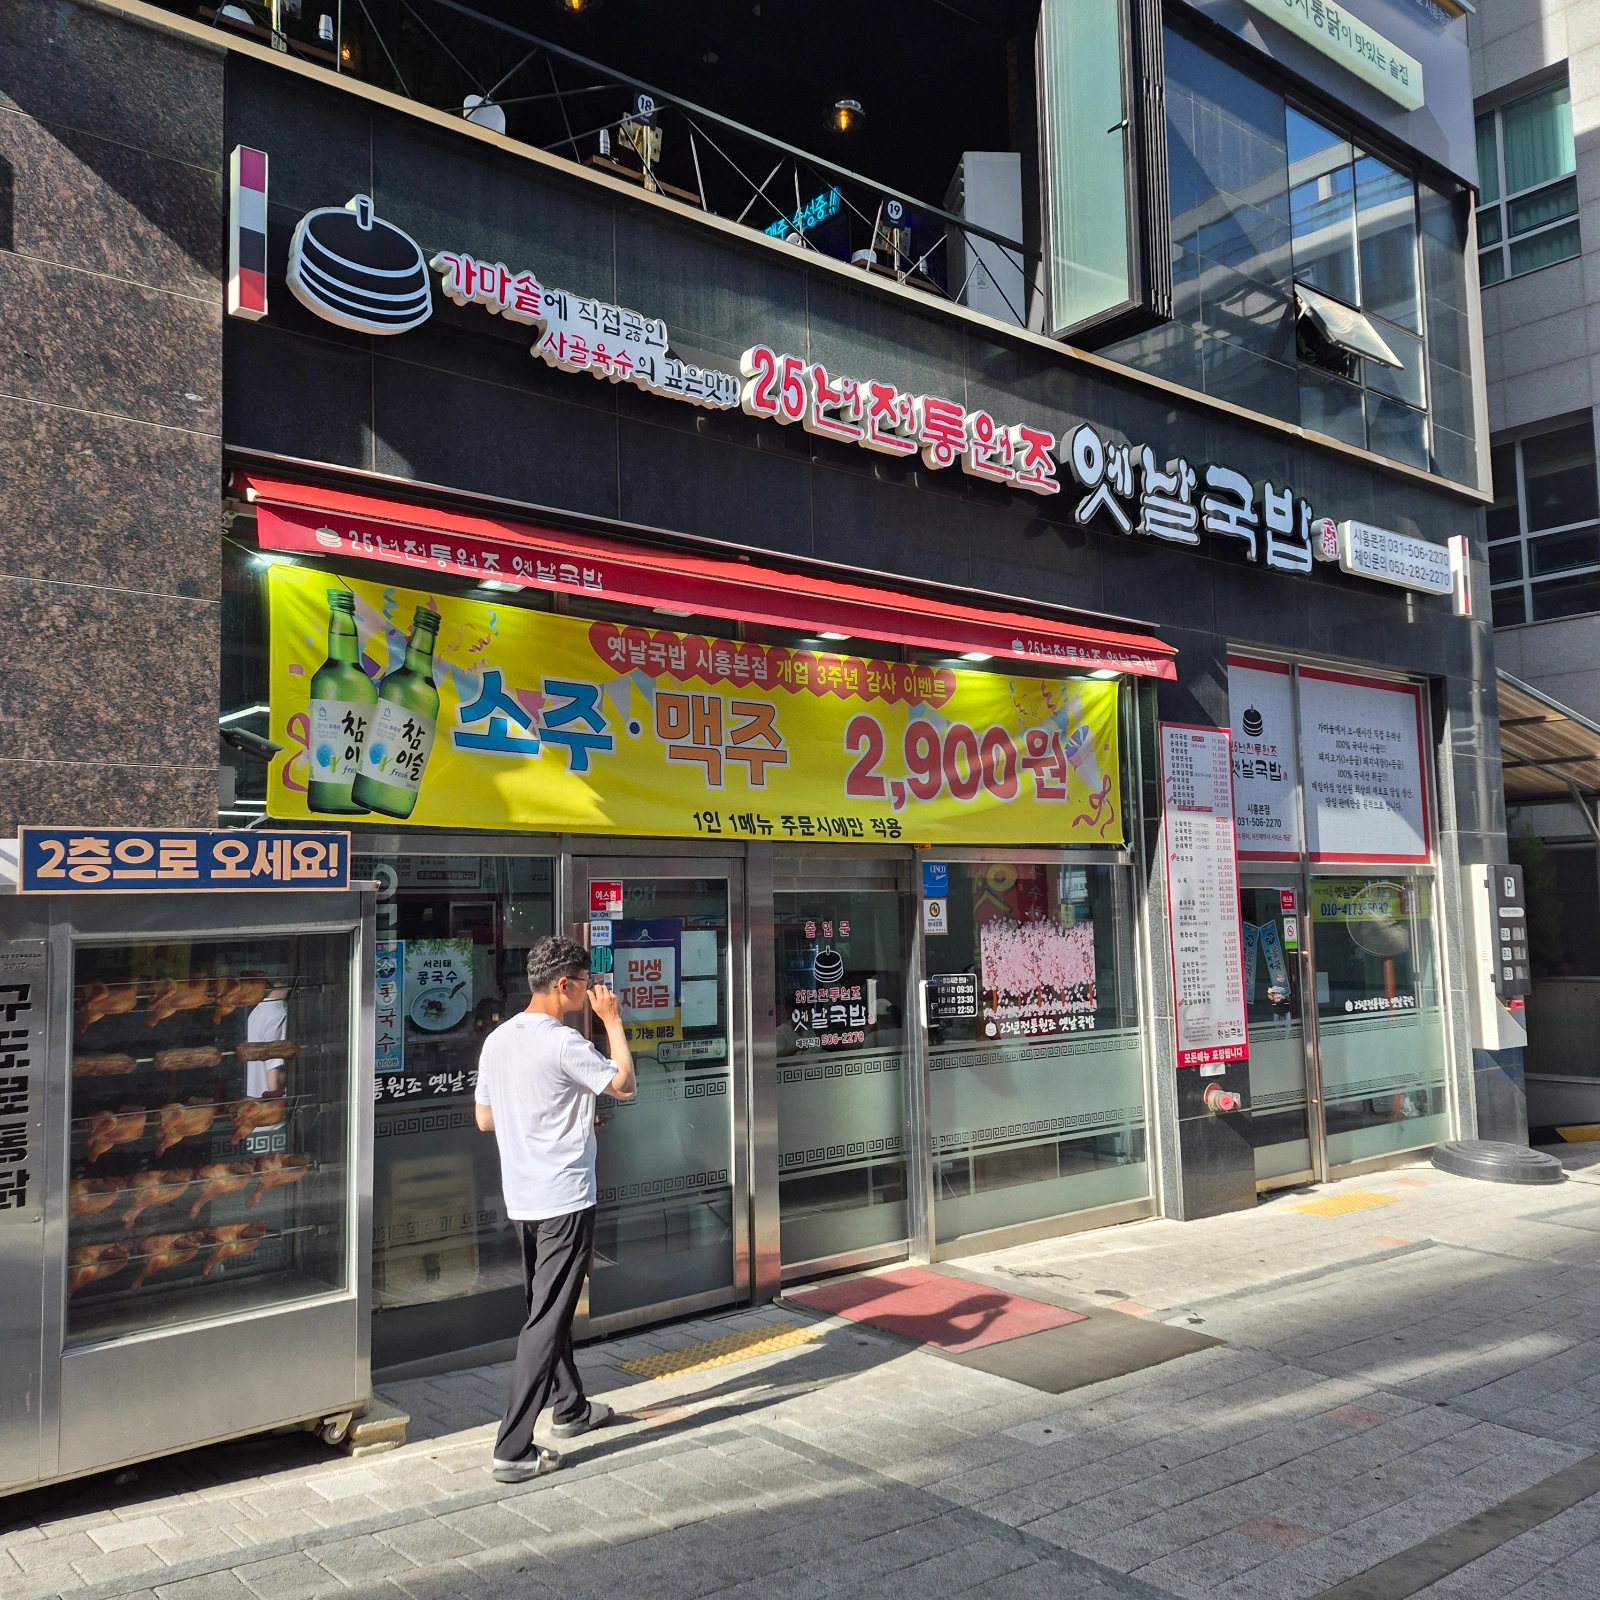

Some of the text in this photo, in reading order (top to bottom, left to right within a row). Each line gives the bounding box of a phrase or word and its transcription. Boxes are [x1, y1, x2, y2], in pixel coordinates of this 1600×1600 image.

[1355, 33, 1386, 71] 맛있는
[1389, 58, 1409, 86] 술집
[640, 97, 652, 111] 18
[890, 203, 901, 216] 19
[442, 255, 568, 320] 가마솥에
[543, 332, 656, 382] 사골육수의
[752, 346, 1060, 493] 25년전통원조
[1072, 424, 1313, 574] 옛날국밥
[1353, 528, 1449, 566] 시흥본점 031-506-2270
[349, 530, 603, 592] 25년전통원조 옛날국밥
[1354, 549, 1450, 586] 체인문의 052-282-2270
[1027, 640, 1158, 672] 25년전통원조 옛날국밥
[607, 636, 947, 700] 옛날국밥 시흥본점 개업 3주년 감사 이벤트
[1335, 740, 1369, 752] 100% 국내산
[389, 768, 409, 779] fresh
[1337, 769, 1370, 781] 100% 국내산
[693, 811, 903, 839] 1인 1메뉴 주문시에만 적용
[1237, 817, 1281, 828] 031-506-2270
[36, 836, 338, 883] 2층으로 오세요!
[595, 890, 617, 900] 에스원
[1501, 929, 1509, 938] B1
[1503, 949, 1510, 958] B2
[423, 959, 452, 968] 서리태
[628, 959, 662, 982] 민생
[417, 971, 458, 985] 콩국수
[1504, 969, 1512, 977] B3
[956, 985, 973, 993] 09:30
[619, 985, 671, 1011] 지원금
[791, 1003, 866, 1032] 옛날국밥
[957, 1006, 974, 1014] 22:50
[377, 983, 397, 1054] 콩국수
[1000, 1015, 1096, 1035] 25년전통원조 옛날국밥
[636, 1026, 675, 1040] 가능 매장
[821, 1031, 865, 1046] 506-2270
[661, 1049, 670, 1057] 19
[1184, 1046, 1243, 1064] 모든메뉴 포장됩니다
[377, 1058, 398, 1067] 000원
